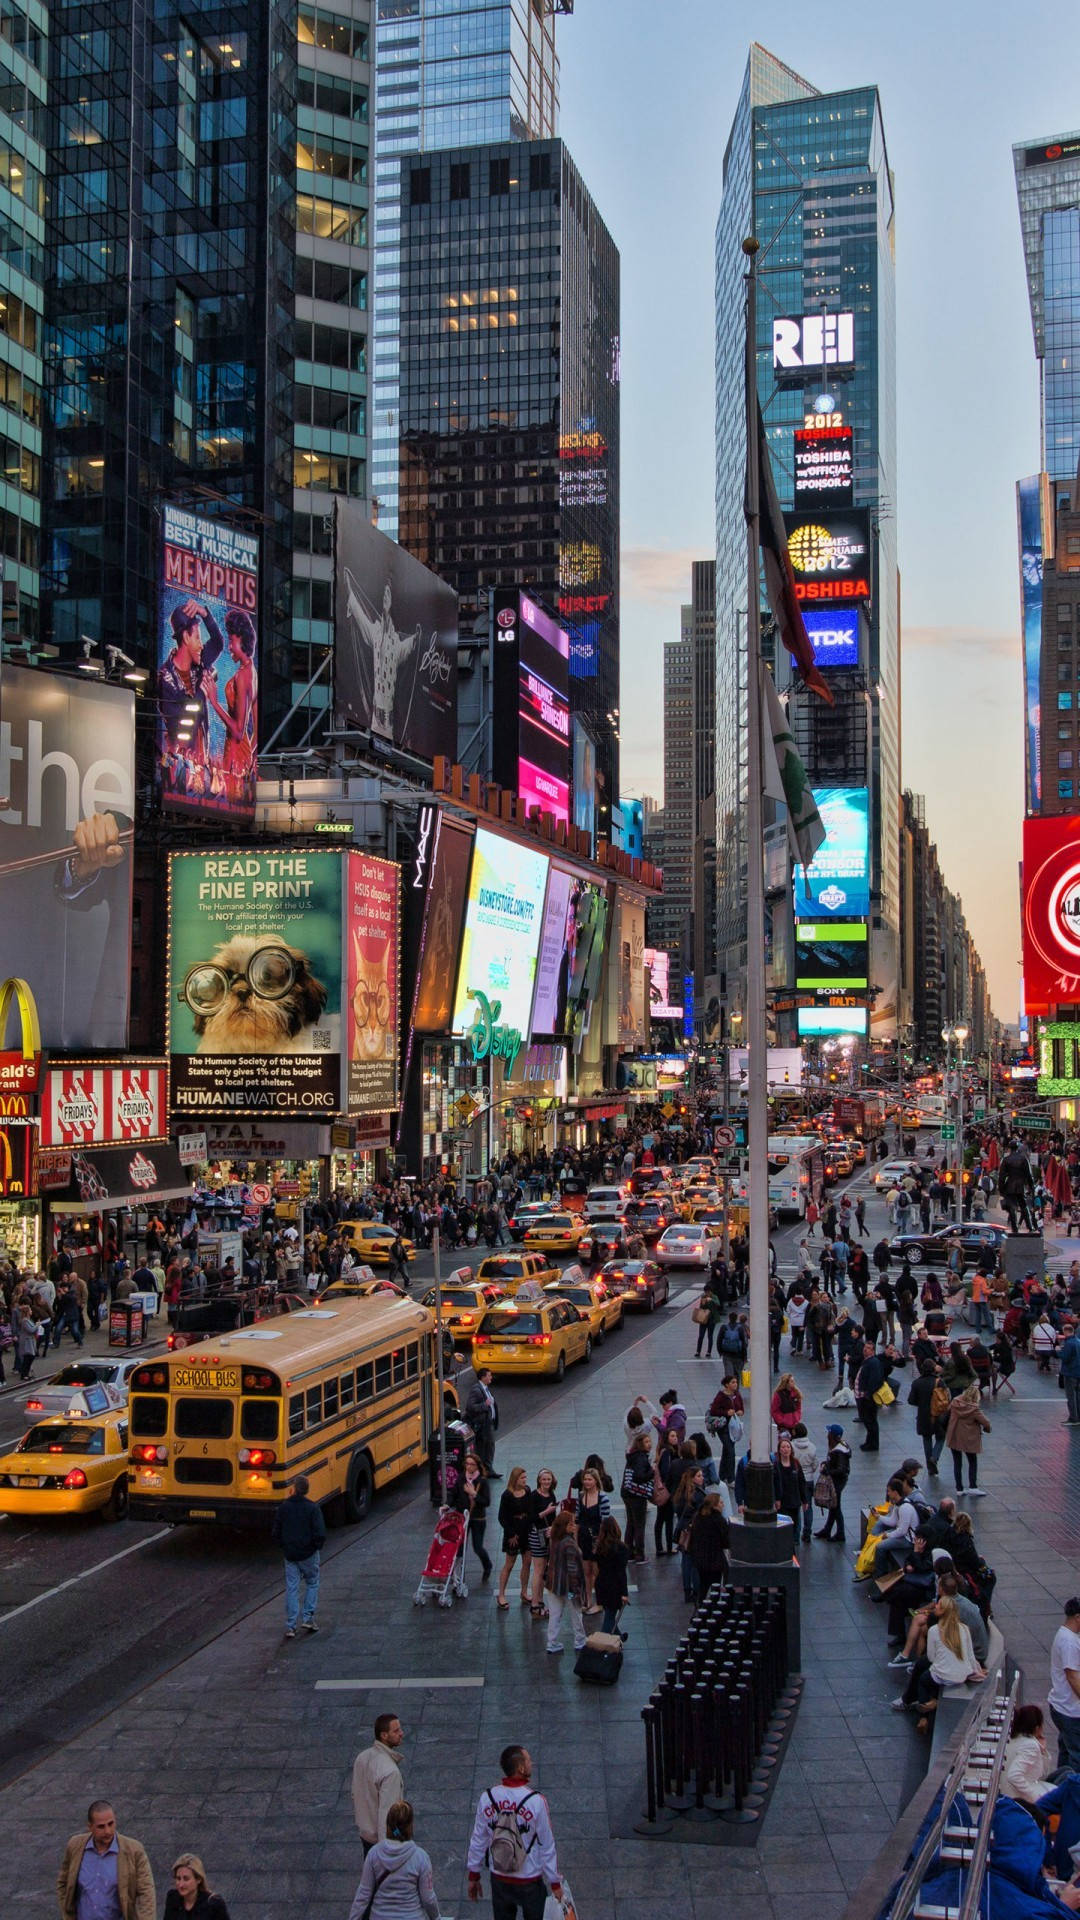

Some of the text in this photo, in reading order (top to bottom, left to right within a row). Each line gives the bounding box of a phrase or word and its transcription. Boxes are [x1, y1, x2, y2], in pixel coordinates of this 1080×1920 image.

[774, 314, 853, 368] REI
[804, 414, 842, 429] 2012
[796, 427, 852, 440] TOSHIBA
[796, 450, 851, 464] TOSHIBA
[807, 464, 850, 476] OFFICIAL
[796, 478, 841, 490] SPONSOR
[166, 505, 257, 554] WINNER! 2010 TONY AWARD
[165, 522, 199, 548] BEST
[202, 538, 257, 571] MUSICAL
[818, 536, 849, 546] TIMES
[824, 545, 864, 555] SQUARE
[165, 546, 256, 608] MEMPHIS
[794, 580, 868, 599] OSHIBA
[498, 630, 515, 642] LG
[808, 630, 854, 646] TDK
[0, 719, 133, 831] the
[205, 859, 307, 878] READ THE
[362, 864, 377, 880] Don't
[200, 880, 314, 899] FINE PRINT
[354, 882, 391, 904] HSUS disguise
[246, 902, 273, 912] Society
[299, 902, 314, 910] U.S.
[354, 902, 368, 916] itself
[368, 907, 374, 918] as
[380, 908, 391, 920] local
[208, 912, 304, 922] is NOT affiliated with your
[225, 922, 286, 932] local pet shelter.
[358, 925, 387, 940] pet shelter.
[468, 989, 522, 1080] Disney
[238, 1057, 267, 1067] Society
[270, 1057, 278, 1065] of
[295, 1057, 322, 1065] United
[1, 1065, 35, 1078] ald's
[215, 1068, 232, 1077] only
[233, 1068, 254, 1077] gives
[293, 1068, 322, 1077] budget
[246, 1079, 259, 1087] pet
[261, 1078, 294, 1086] shelters.
[176, 1092, 334, 1106] HUMANEWATCH.ORG
[176, 1370, 236, 1386] SCHOOL BUS
[203, 1443, 208, 1454] 6
[484, 1800, 534, 1821] CHICAGO
